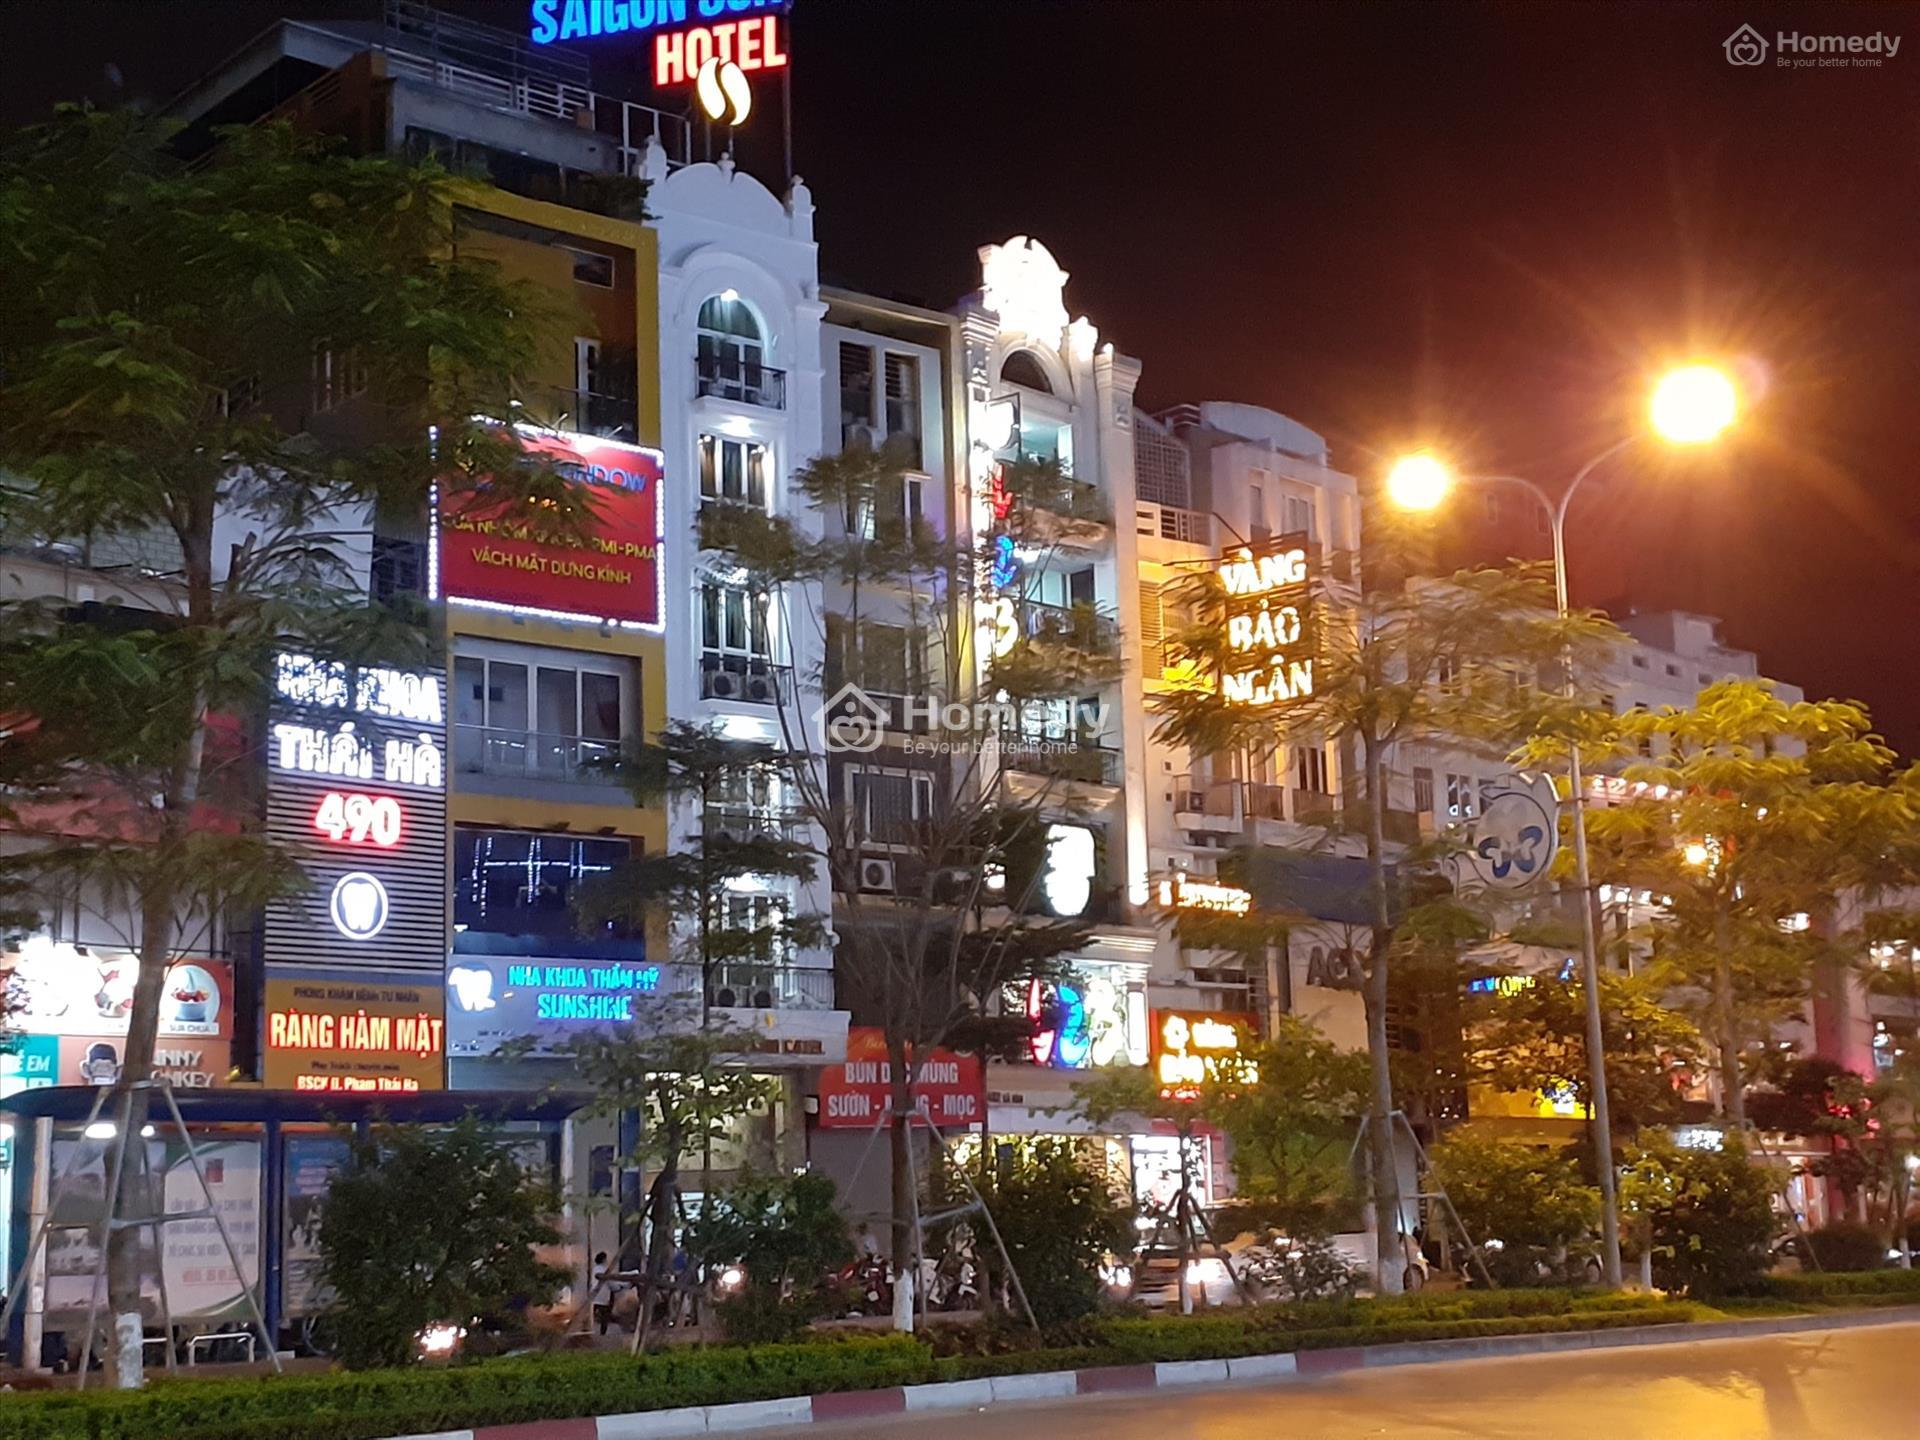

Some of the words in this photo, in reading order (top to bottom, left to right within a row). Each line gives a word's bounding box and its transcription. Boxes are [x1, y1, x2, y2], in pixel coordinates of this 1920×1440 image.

[656, 16, 787, 86] HOTEL
[472, 546, 512, 567] VÁCH
[598, 564, 632, 585] KÍNH
[385, 733, 441, 787] HÀ
[315, 793, 401, 845] 490
[509, 966, 541, 986] NHA
[545, 967, 586, 988] KHOA
[538, 993, 632, 1020] SUNSHINE
[270, 1008, 334, 1049] RĂNG
[340, 1009, 390, 1050] HÀM
[396, 1012, 442, 1059] MẶT
[845, 1058, 877, 1084] BÚN
[943, 1094, 975, 1120] MỌC
